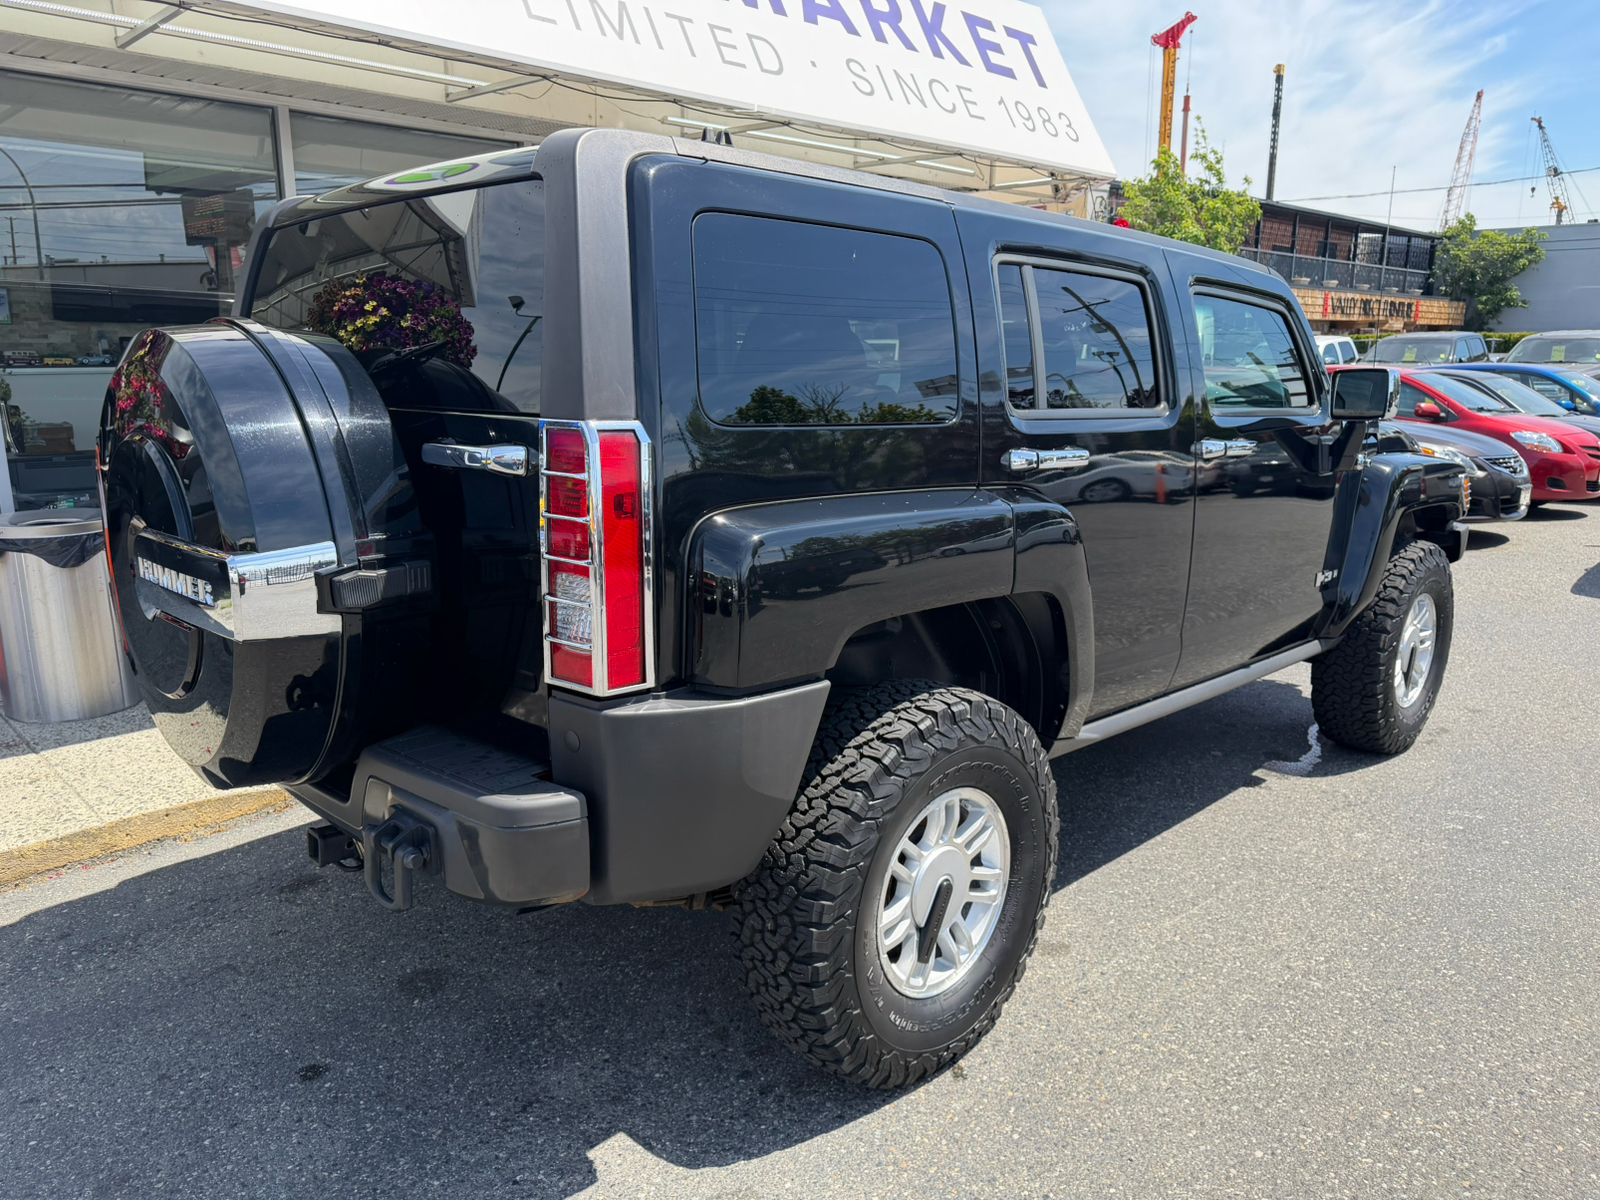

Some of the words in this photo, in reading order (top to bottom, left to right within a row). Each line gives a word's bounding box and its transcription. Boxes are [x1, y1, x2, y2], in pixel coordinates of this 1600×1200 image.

[724, 0, 1048, 89] ARKET
[845, 58, 985, 121] SINCE
[998, 97, 1080, 143] 1983
[137, 556, 215, 607] HUMMER
